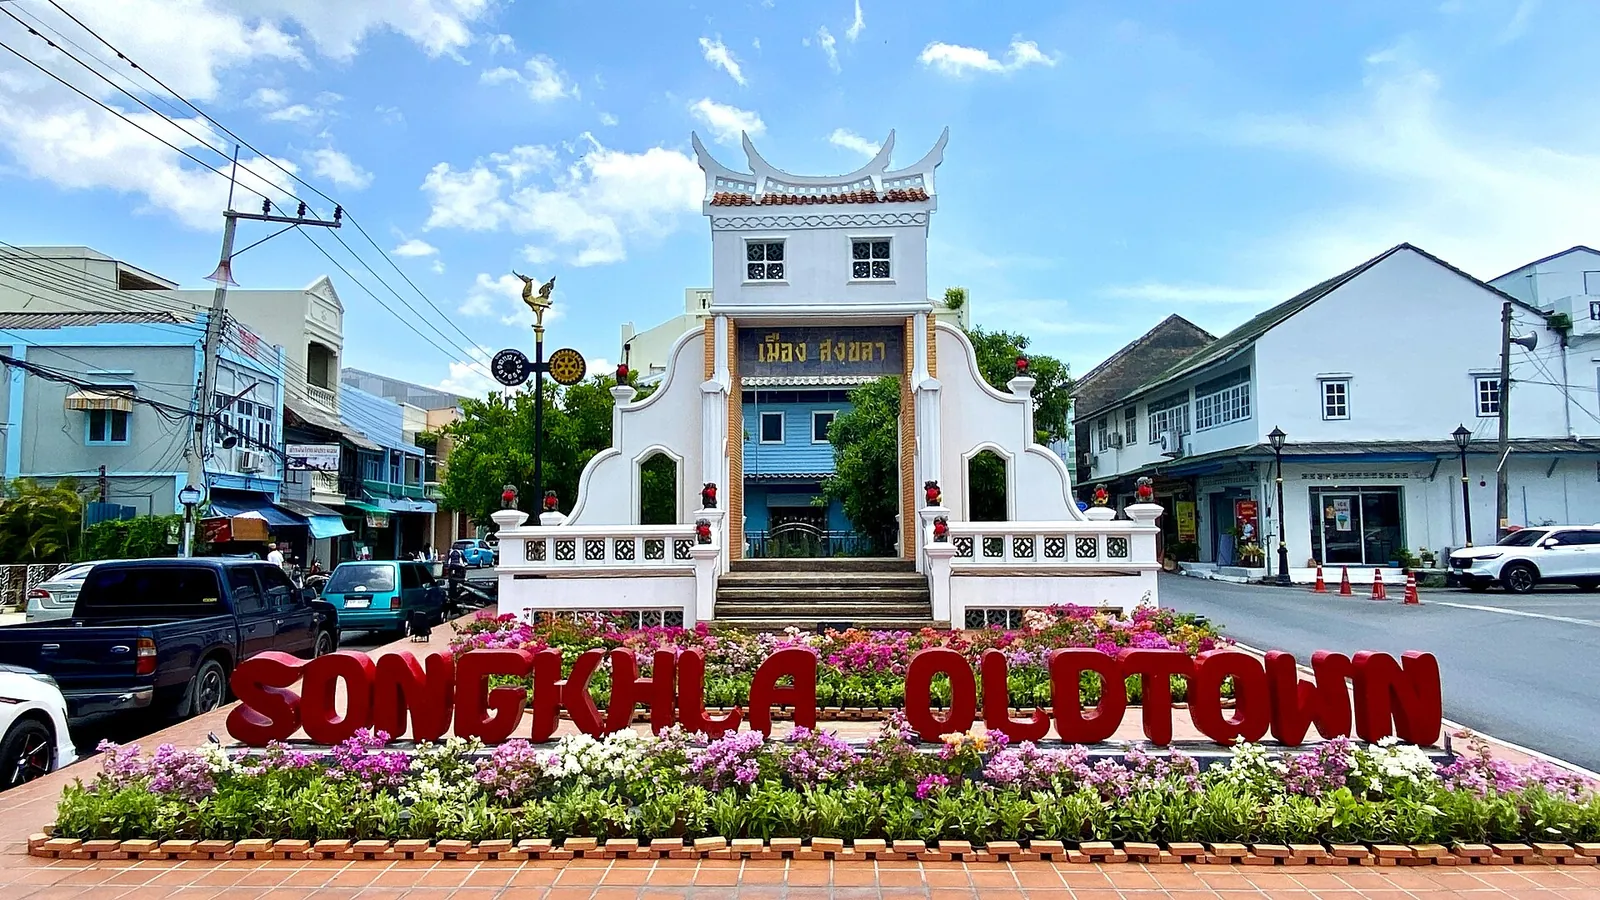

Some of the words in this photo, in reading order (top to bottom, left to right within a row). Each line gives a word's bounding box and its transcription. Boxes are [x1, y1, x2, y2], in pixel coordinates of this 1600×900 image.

[759, 333, 806, 362] เมือง
[819, 338, 886, 362] สงขลา
[226, 647, 816, 746] SONGKHLA
[904, 648, 1442, 747] OLDTOWN
